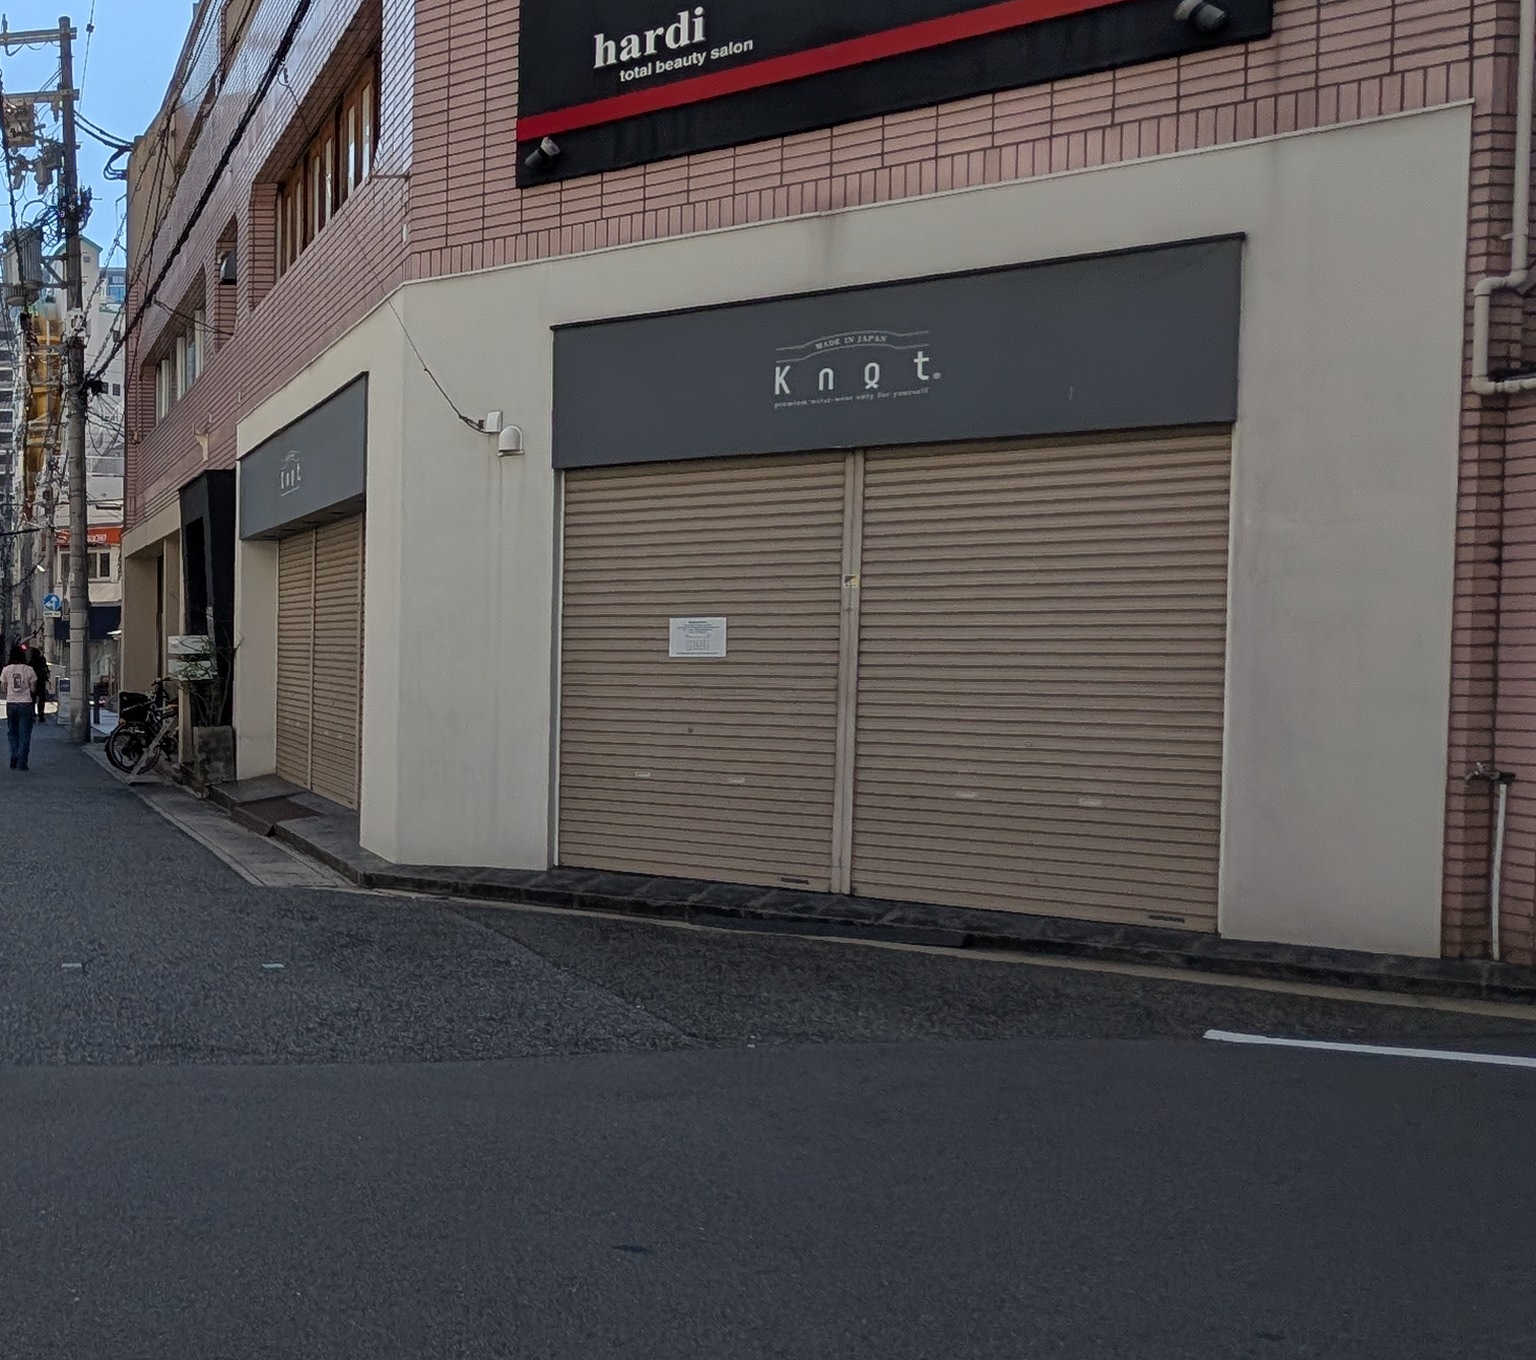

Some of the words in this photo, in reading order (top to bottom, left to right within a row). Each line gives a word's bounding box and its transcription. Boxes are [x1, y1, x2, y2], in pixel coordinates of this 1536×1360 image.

[593, 6, 707, 70] hardi
[619, 62, 653, 82] total
[655, 50, 707, 74] beauty
[710, 39, 754, 60] salon
[814, 338, 842, 350] MADE
[844, 336, 856, 344] IN
[857, 335, 888, 344] JAPAN
